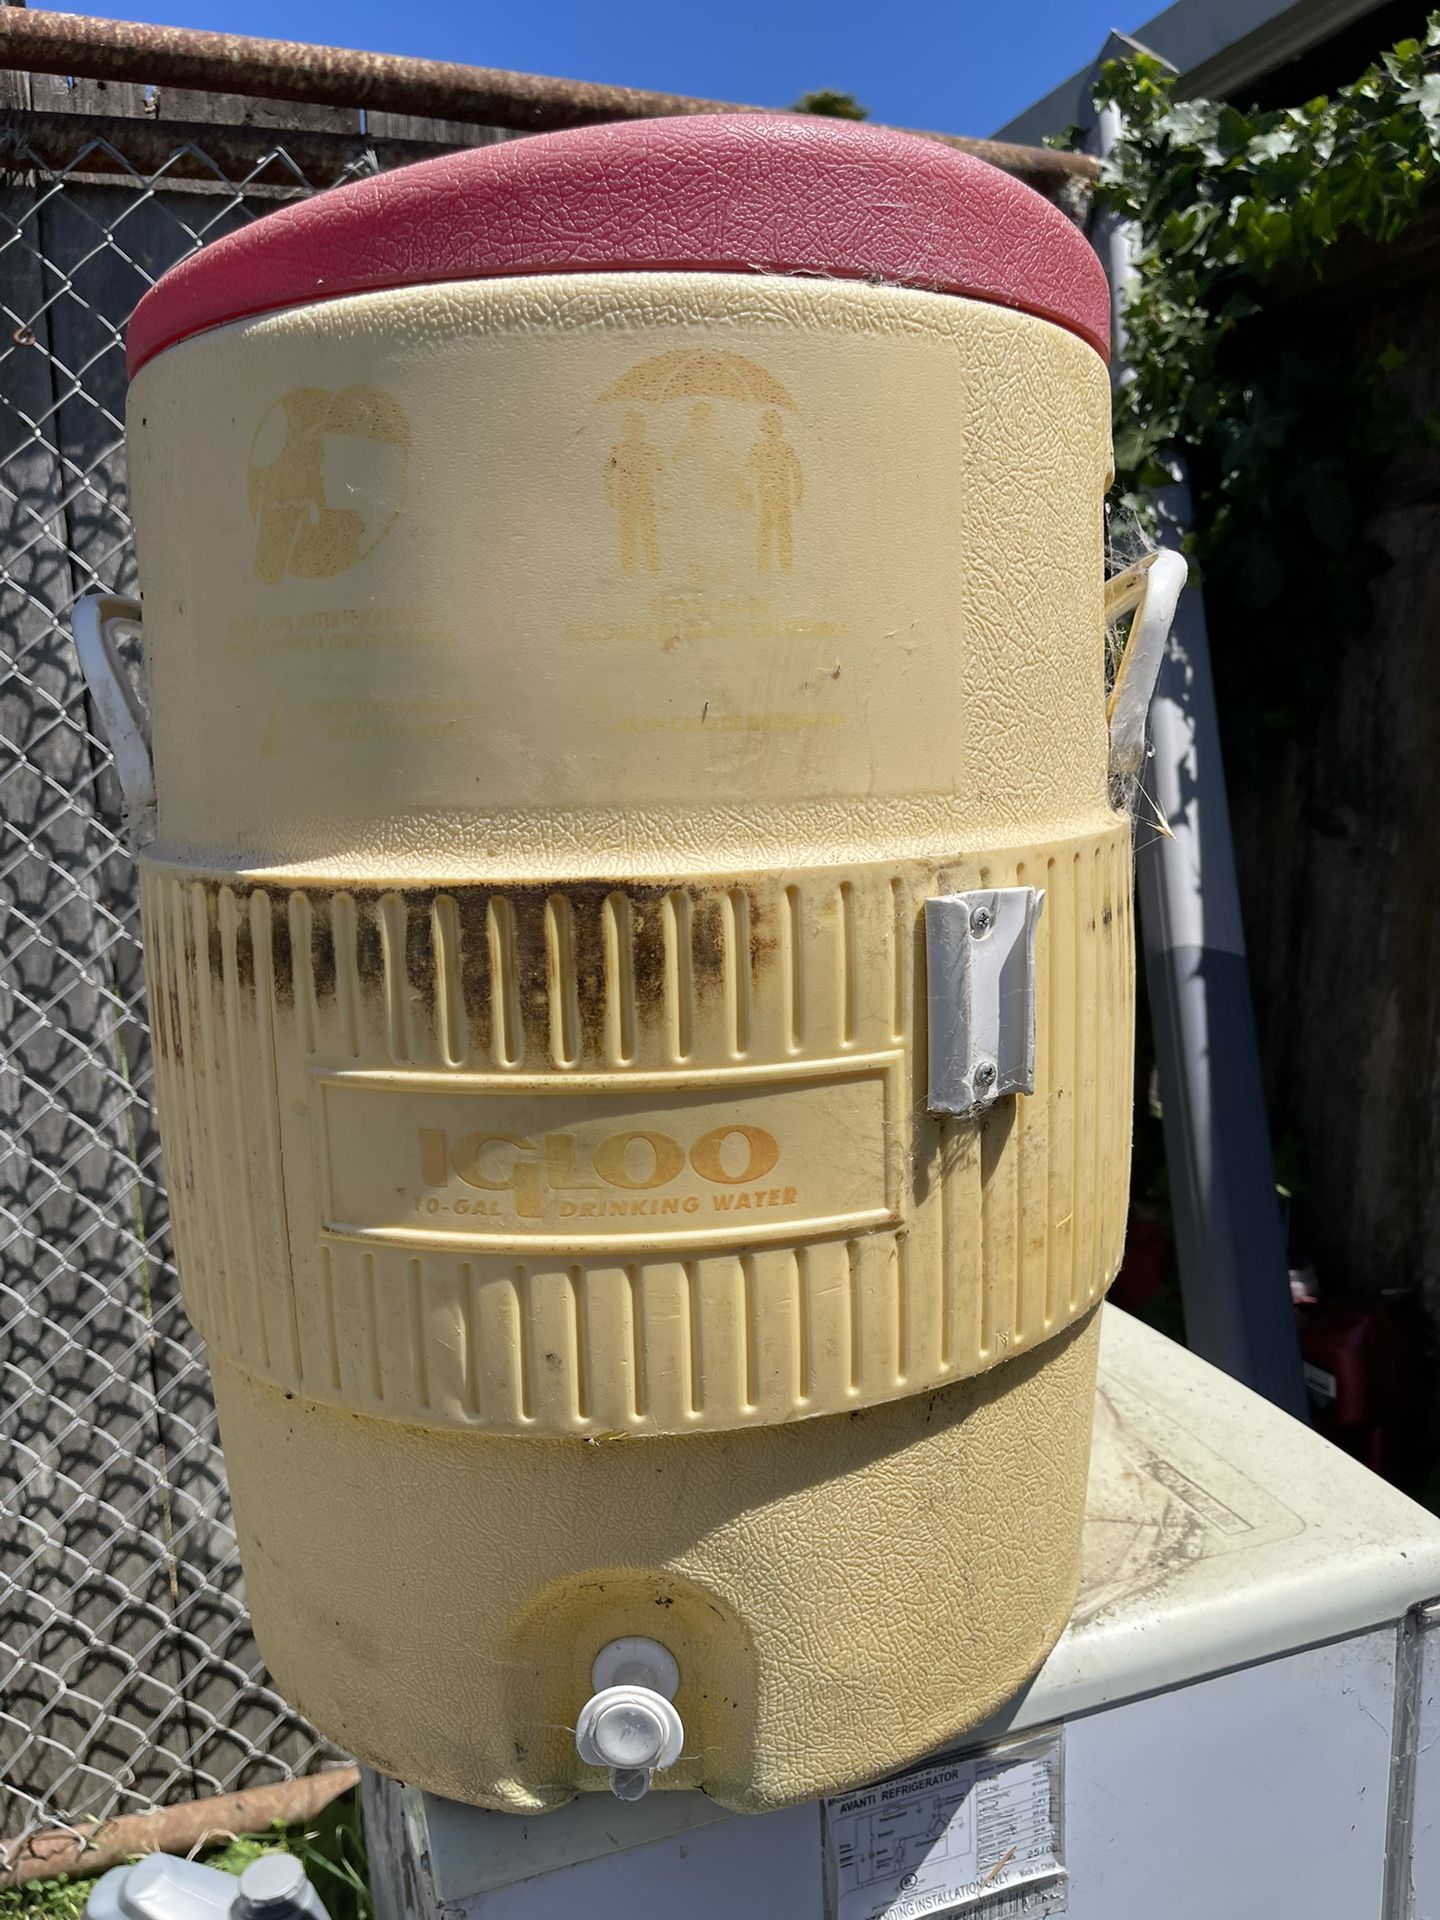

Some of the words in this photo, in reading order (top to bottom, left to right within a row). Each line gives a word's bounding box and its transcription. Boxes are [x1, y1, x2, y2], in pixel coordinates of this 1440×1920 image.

[417, 1124, 780, 1219] IGLOO
[558, 1195, 701, 1218] DRINKING
[712, 1185, 798, 1212] WATER
[840, 1794, 876, 1814] AVANTI
[881, 1768, 959, 1801] REFRIGERATOR
[915, 1877, 984, 1914] INSTALLATION
